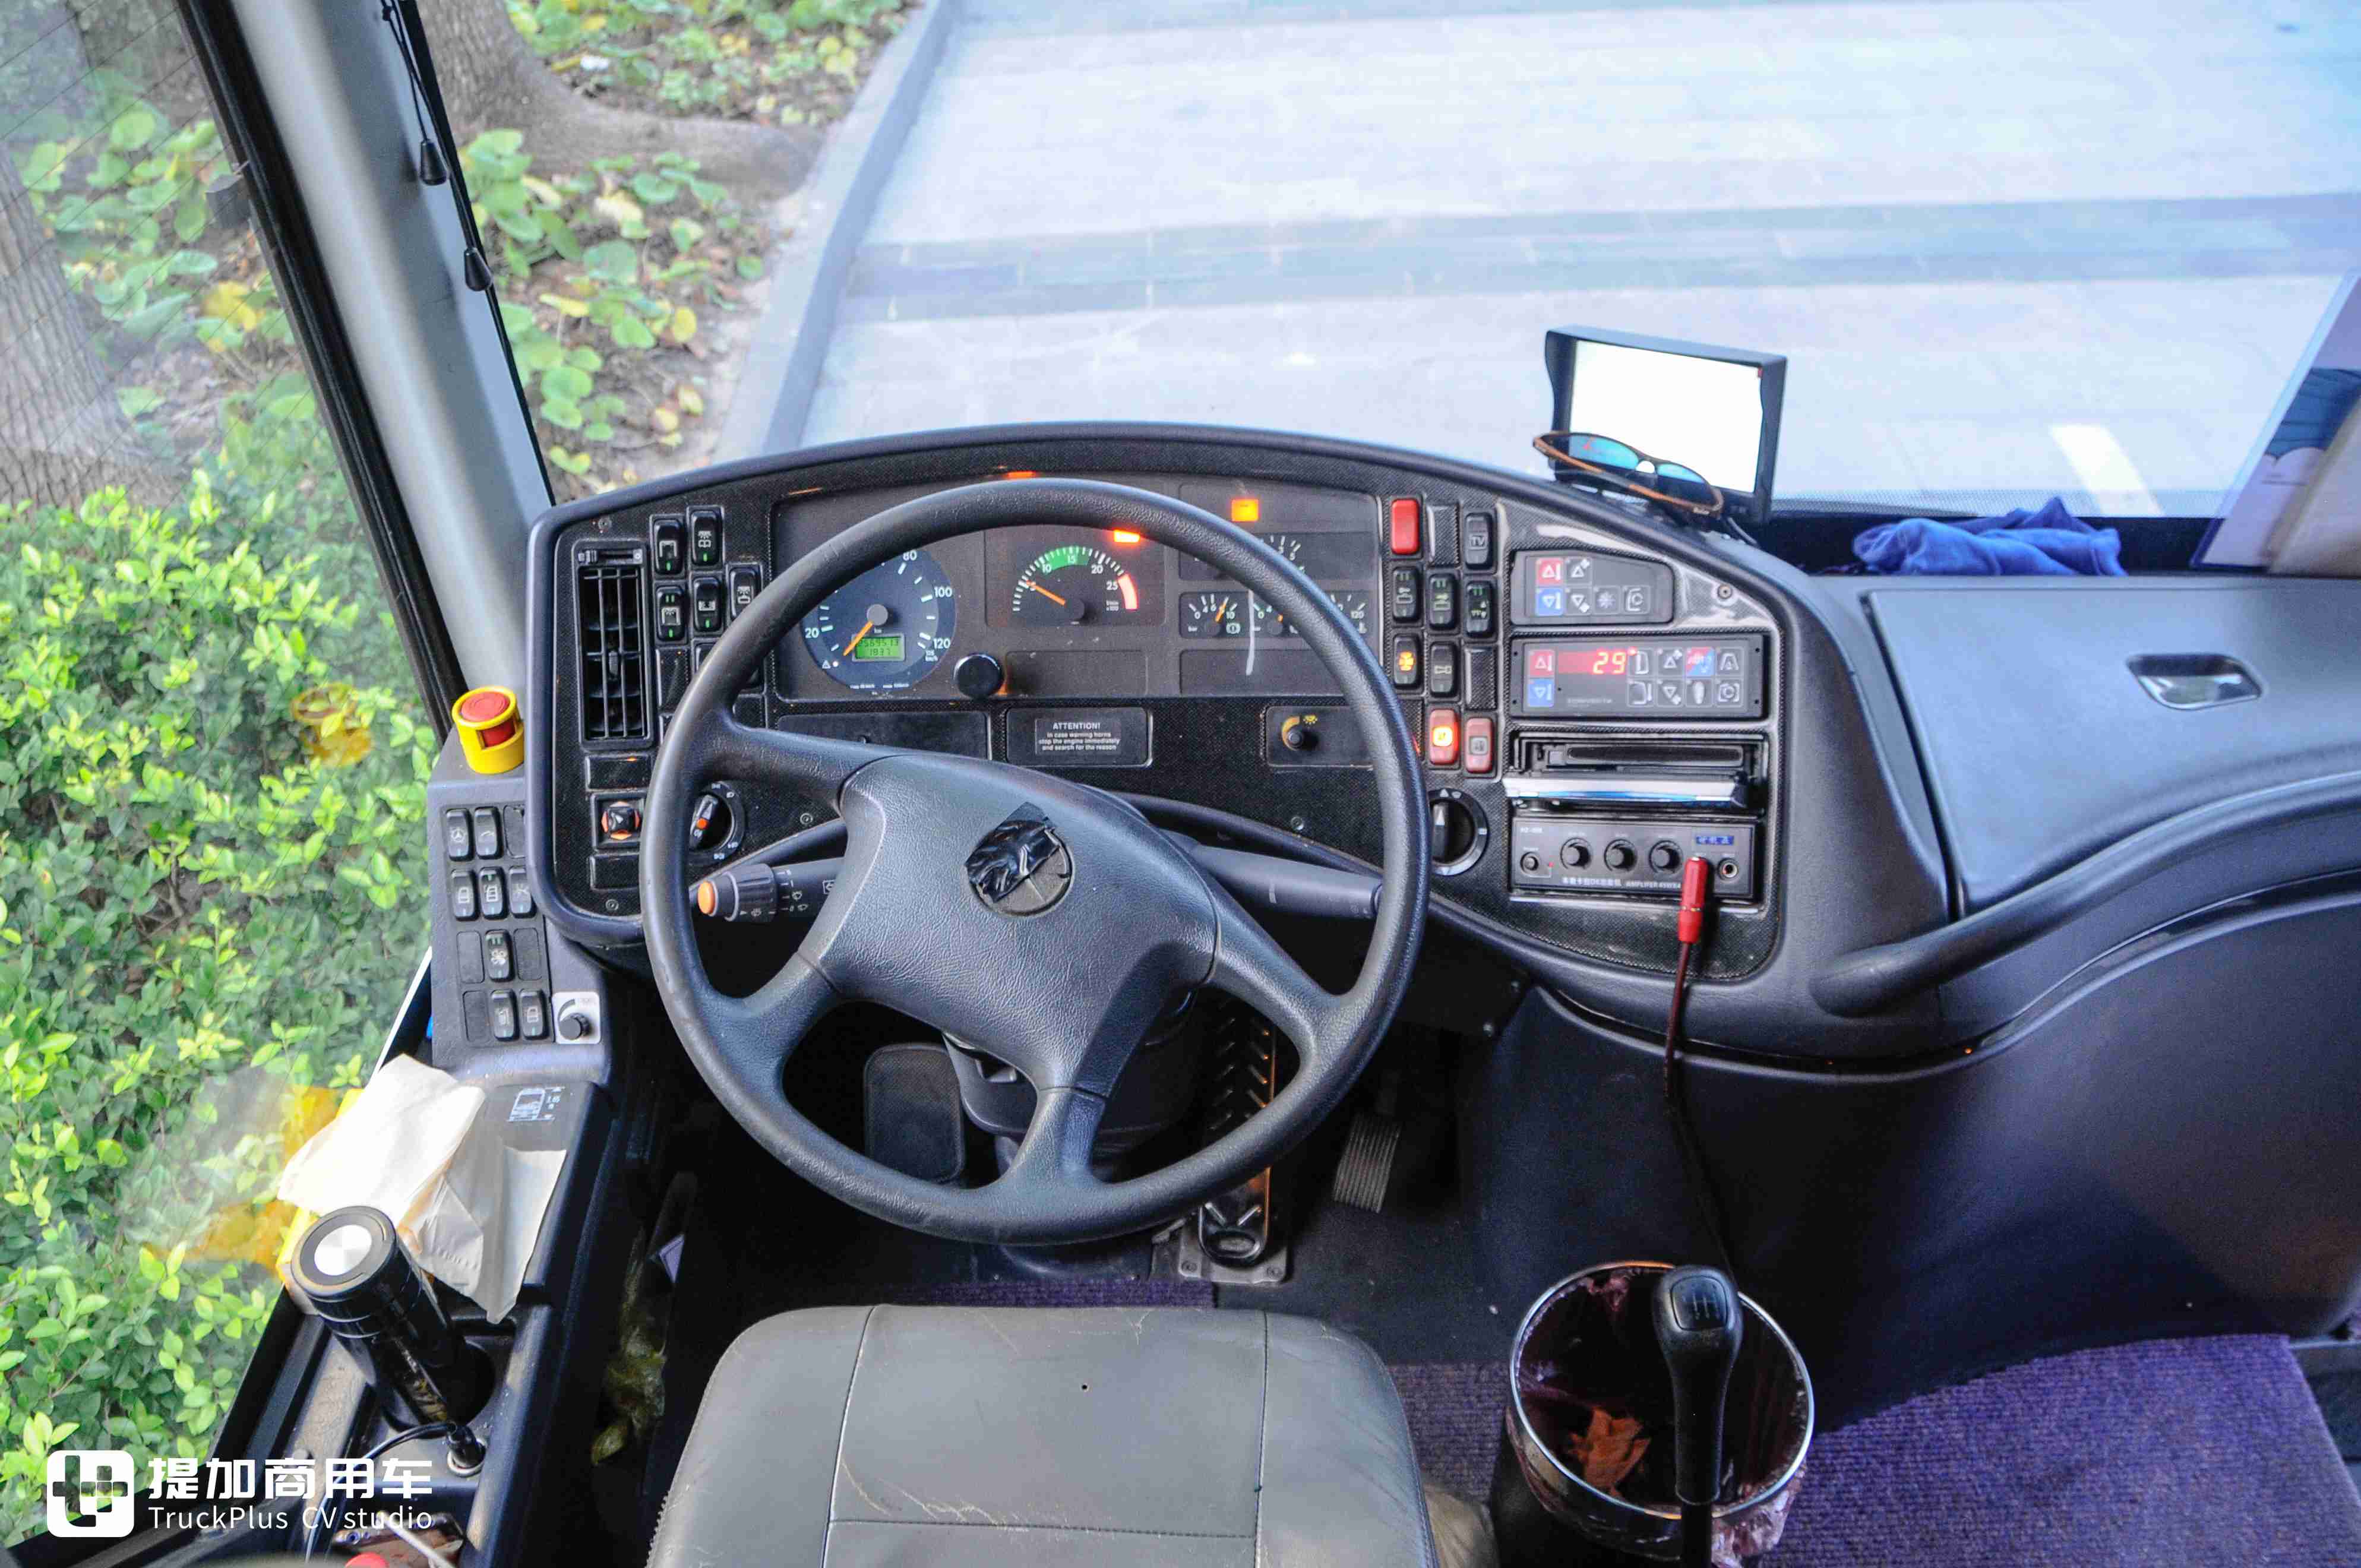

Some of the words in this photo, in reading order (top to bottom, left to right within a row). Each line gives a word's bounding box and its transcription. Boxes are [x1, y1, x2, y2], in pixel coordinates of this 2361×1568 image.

[1469, 536, 1487, 547] TV
[1042, 564, 1051, 574] 10
[1091, 564, 1104, 574] 20
[1106, 580, 1118, 591] 25
[934, 586, 953, 598] 100
[805, 627, 819, 638] 20
[933, 637, 951, 649] 120
[1593, 652, 1625, 674] 29
